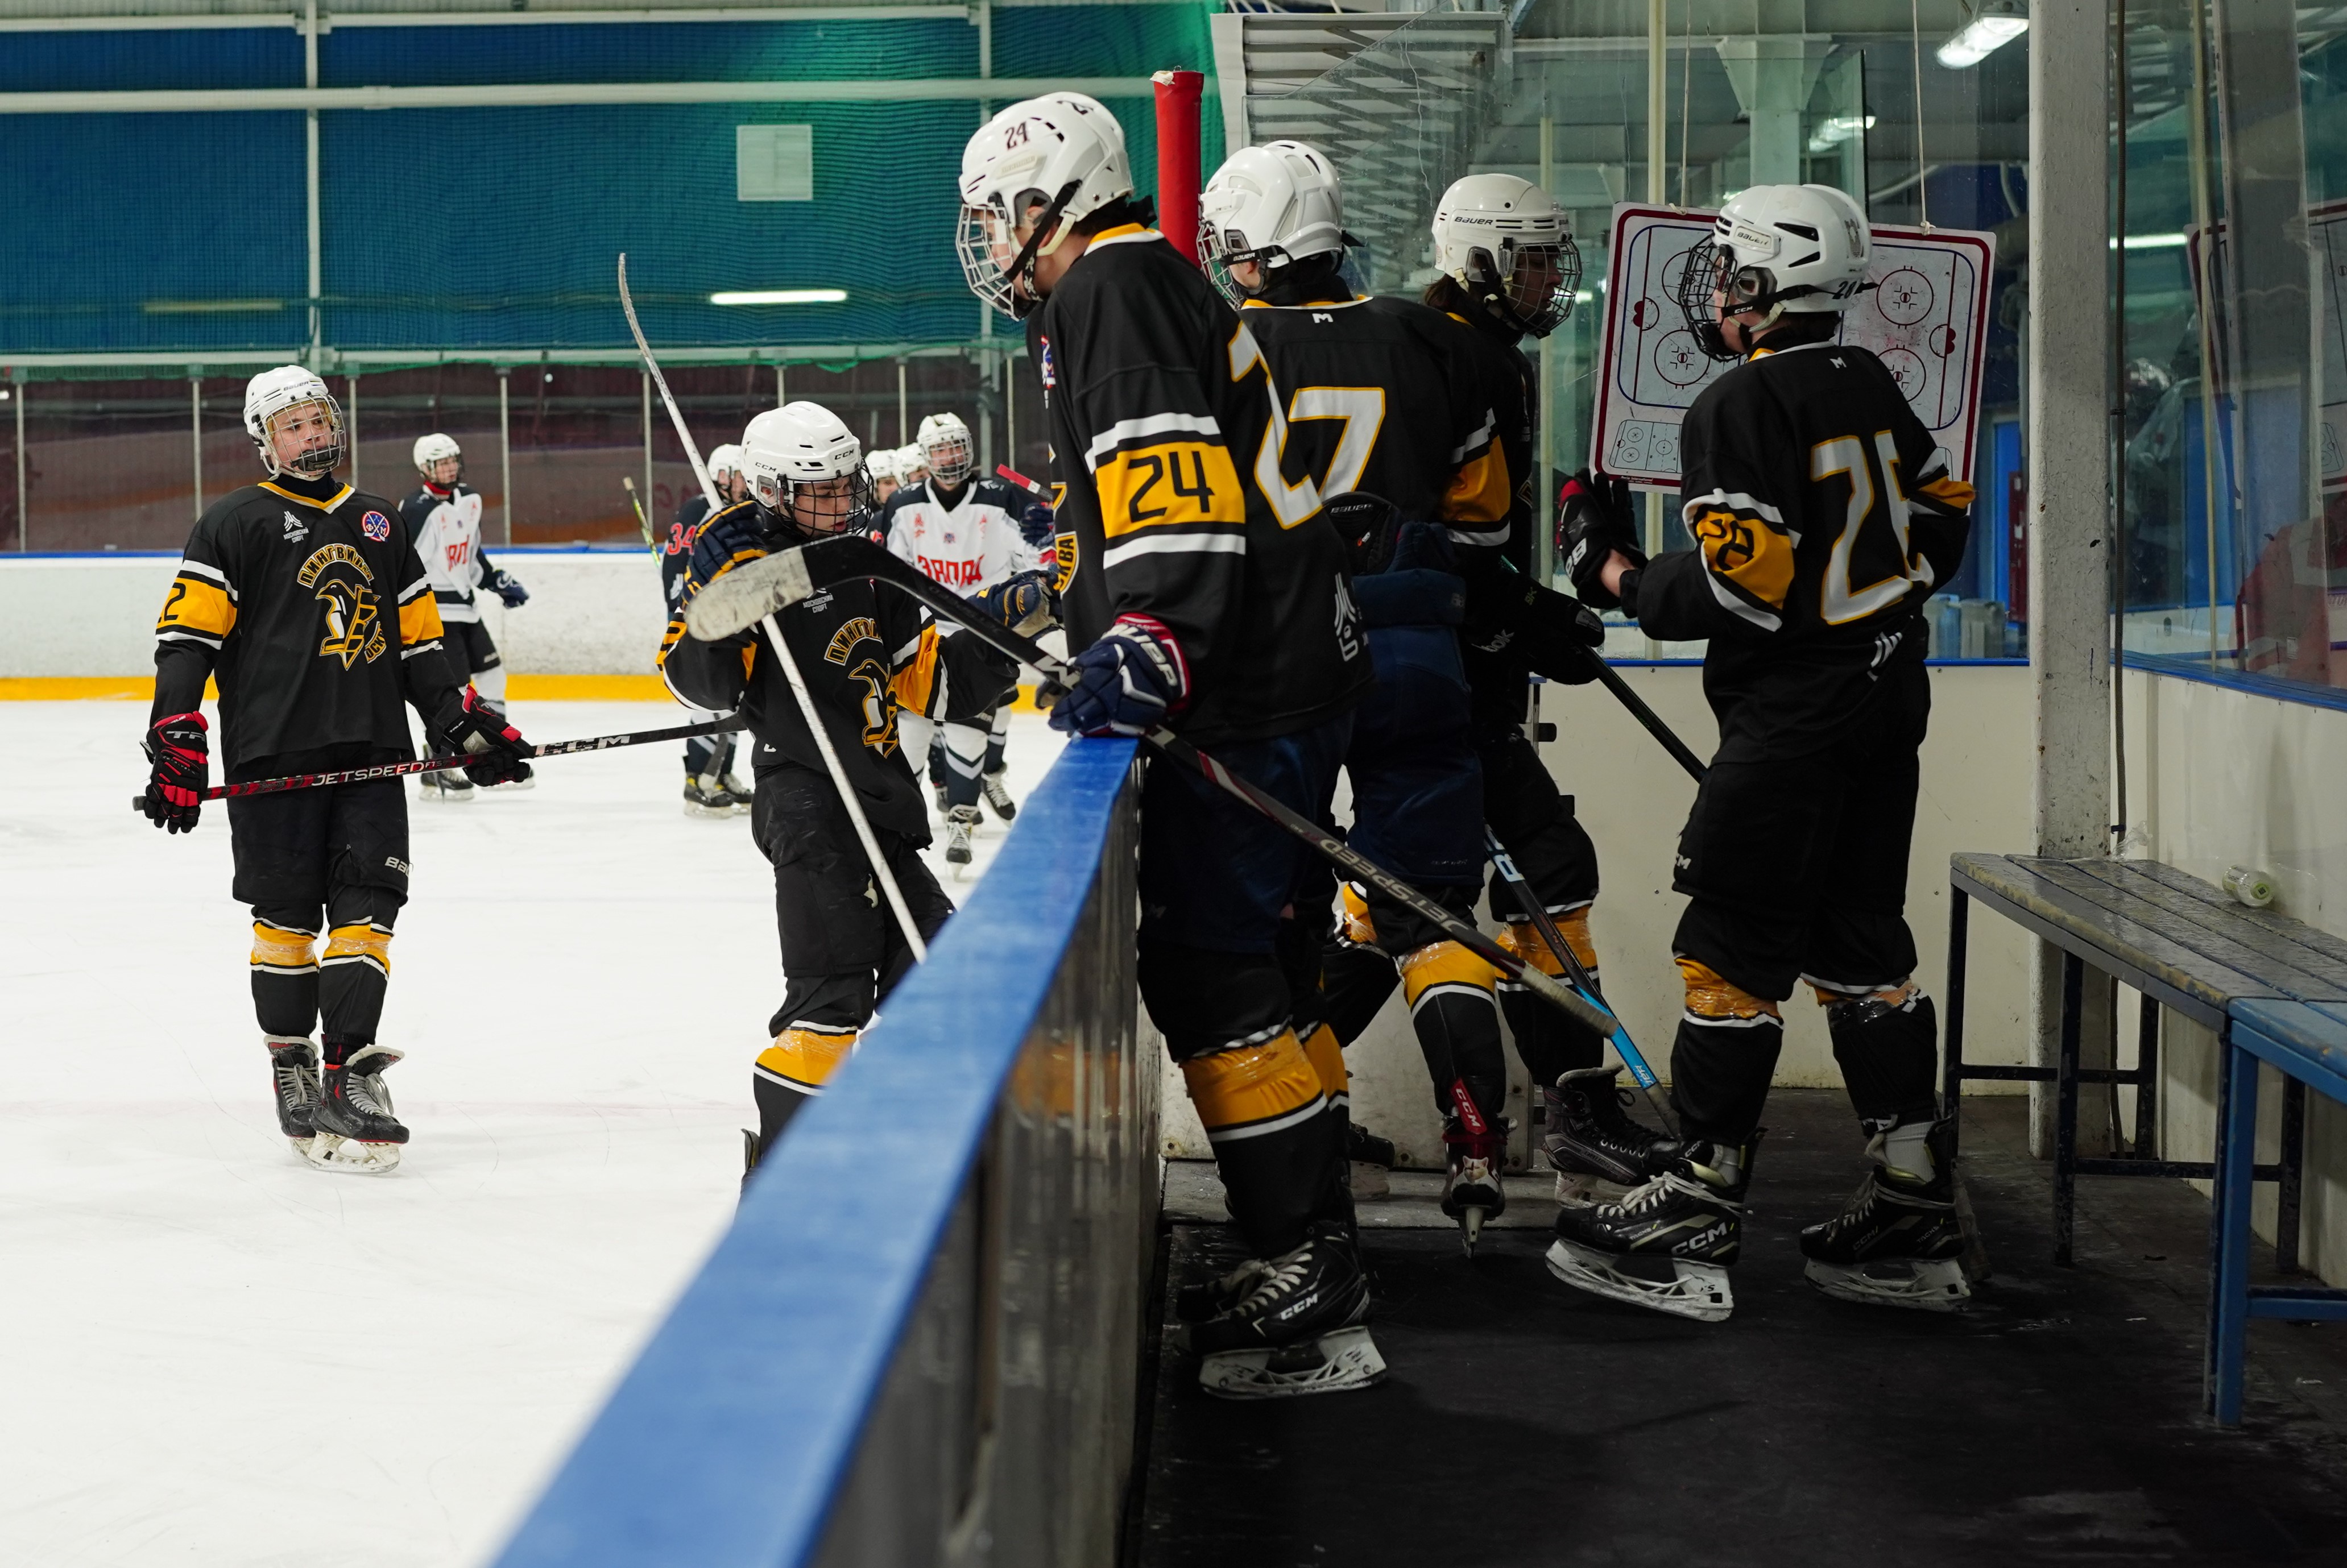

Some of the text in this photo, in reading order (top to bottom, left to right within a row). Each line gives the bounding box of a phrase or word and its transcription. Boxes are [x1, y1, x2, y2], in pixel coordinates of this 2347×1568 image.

[1005, 122, 1029, 150] 24
[1455, 217, 1493, 225] BAUER
[1233, 252, 1256, 262] BAUER
[283, 381, 309, 391] BAUER
[835, 449, 855, 461] CCM
[755, 462, 776, 472] CCM
[1127, 451, 1215, 523] 24
[1330, 503, 1373, 515] BAUER
[667, 522, 697, 555] 34
[157, 582, 187, 625] 2
[802, 593, 834, 608] МОСКОВСКИЙ
[812, 603, 827, 613] СПОРТ
[535, 736, 630, 757] CCM
[311, 762, 424, 786] JETSPEED
[1319, 838, 1470, 933] JETSPEED
[1455, 1088, 1481, 1127] CCM
[1671, 1222, 1727, 1256] CCM
[1852, 1230, 1875, 1251] CCM
[1280, 1293, 1318, 1321] CCM
